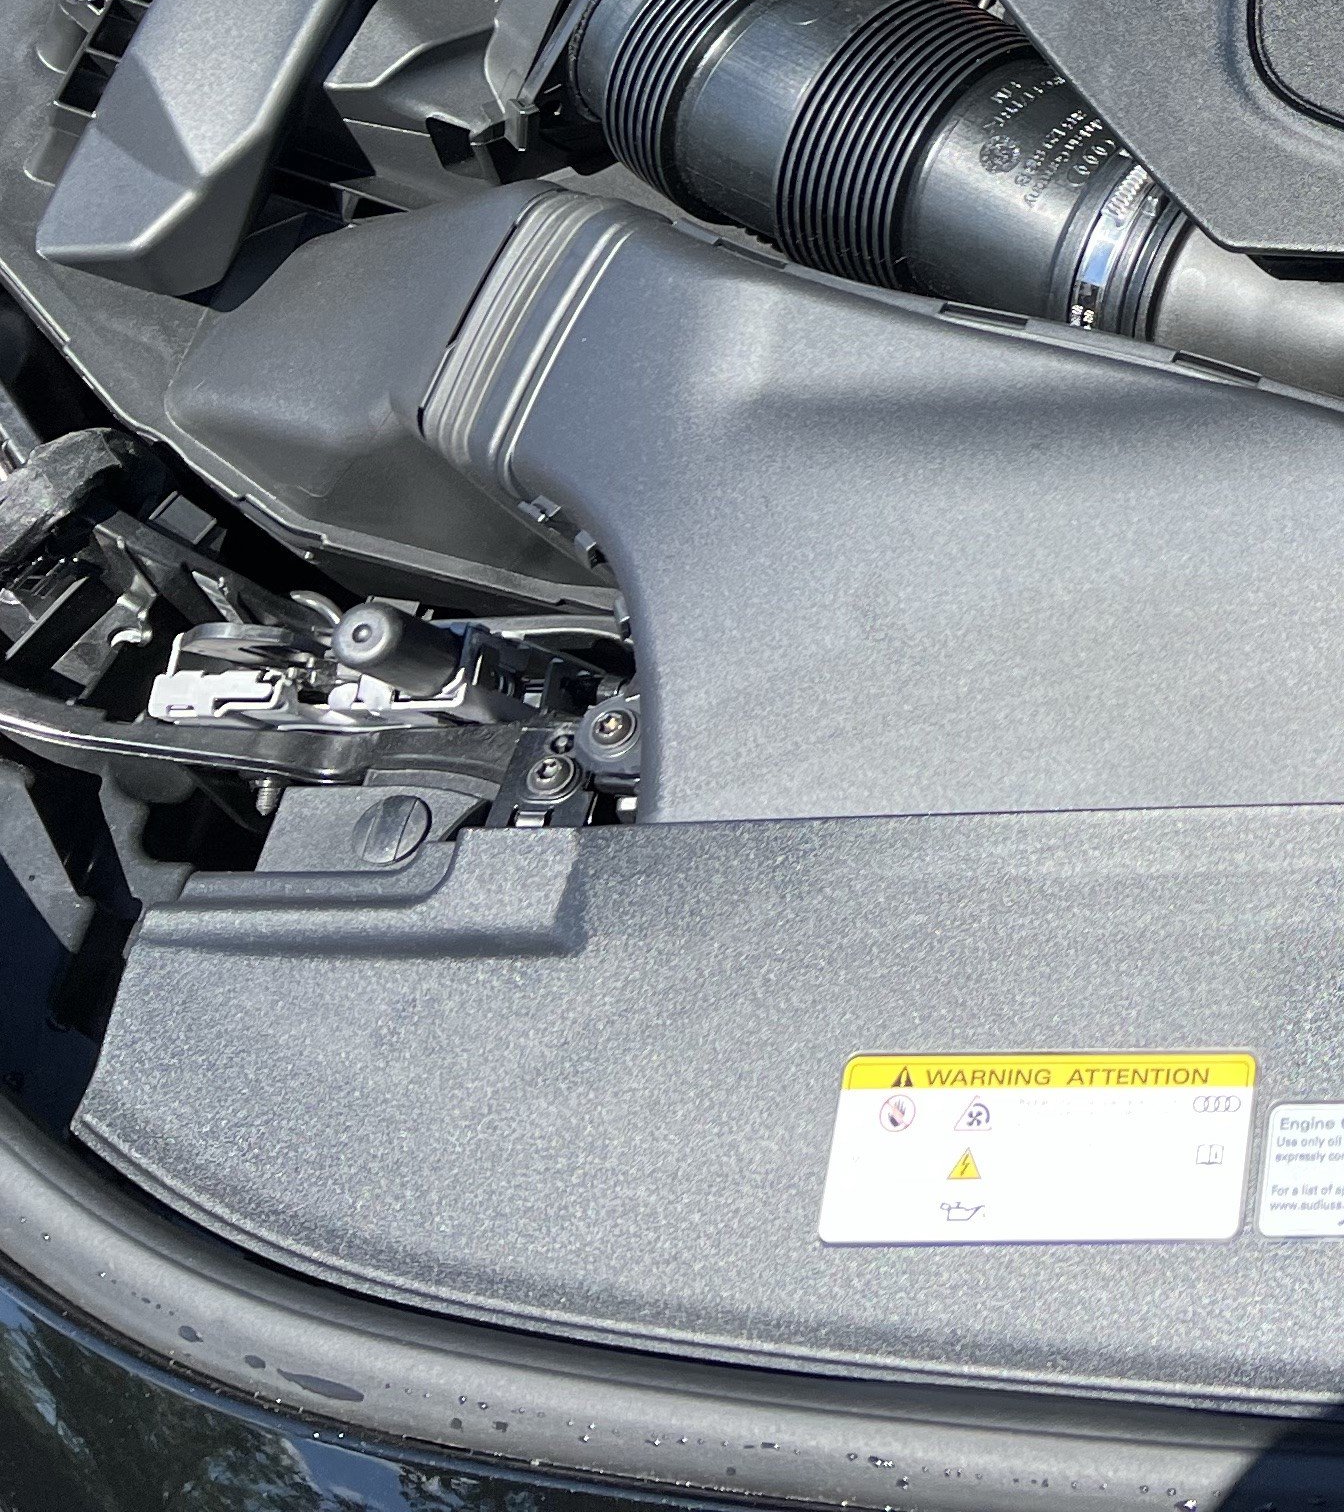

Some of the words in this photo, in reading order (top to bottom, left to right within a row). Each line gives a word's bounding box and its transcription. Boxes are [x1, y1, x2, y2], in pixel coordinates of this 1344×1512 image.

[926, 1068, 1051, 1086] WARNING
[1066, 1067, 1210, 1086] ATTENTION
[1280, 1117, 1336, 1133] Engine
[1276, 1136, 1298, 1147] Use
[1300, 1136, 1326, 1149] only
[1327, 1135, 1343, 1147] oil
[1275, 1151, 1327, 1163] expressly
[1271, 1184, 1288, 1196] For
[1301, 1184, 1318, 1196] list
[1321, 1184, 1333, 1195] of
